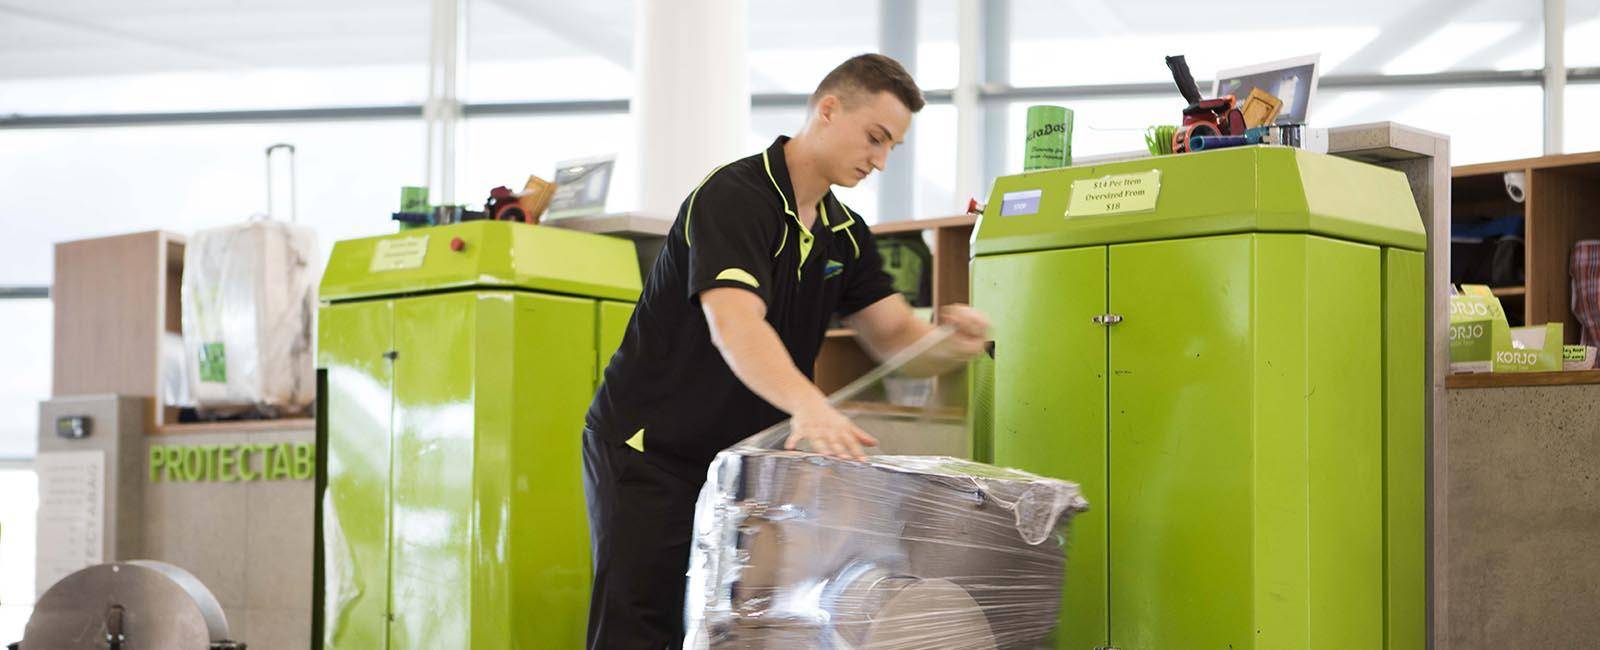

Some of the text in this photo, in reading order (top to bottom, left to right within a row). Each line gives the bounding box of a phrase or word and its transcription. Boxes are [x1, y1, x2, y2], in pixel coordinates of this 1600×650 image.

[1124, 178, 1142, 186] Item
[1085, 189, 1145, 201] Oversized From
[1450, 301, 1488, 316] ORJO
[1450, 324, 1483, 340] ORJO
[1496, 351, 1537, 365] KORJO
[151, 443, 315, 482] PROTECTAB
